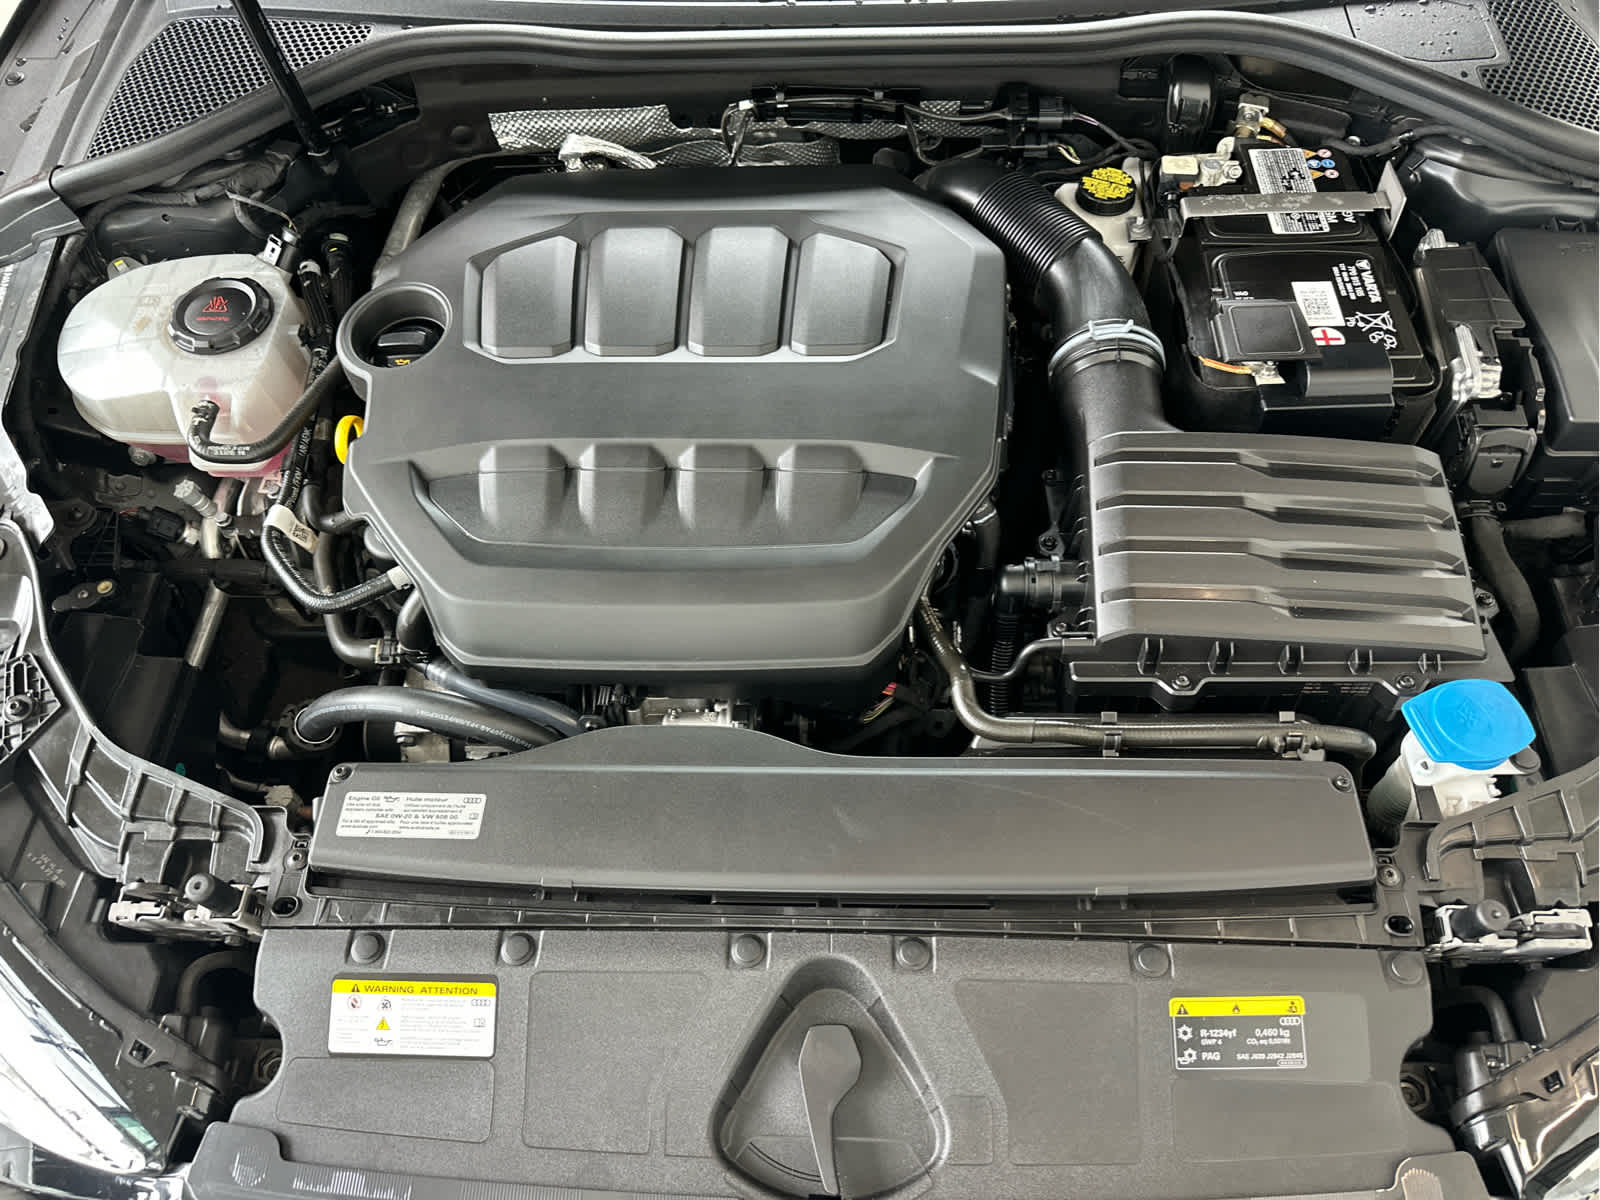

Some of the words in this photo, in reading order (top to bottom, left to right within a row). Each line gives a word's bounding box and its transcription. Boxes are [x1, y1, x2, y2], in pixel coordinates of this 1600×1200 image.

[1361, 270, 1382, 303] VARTA
[364, 985, 414, 994] WARNING
[420, 986, 478, 995] ATTENTION
[1200, 1028, 1237, 1039] R-1234yf
[1280, 1028, 1290, 1037] kg
[1202, 1052, 1221, 1061] PAG
